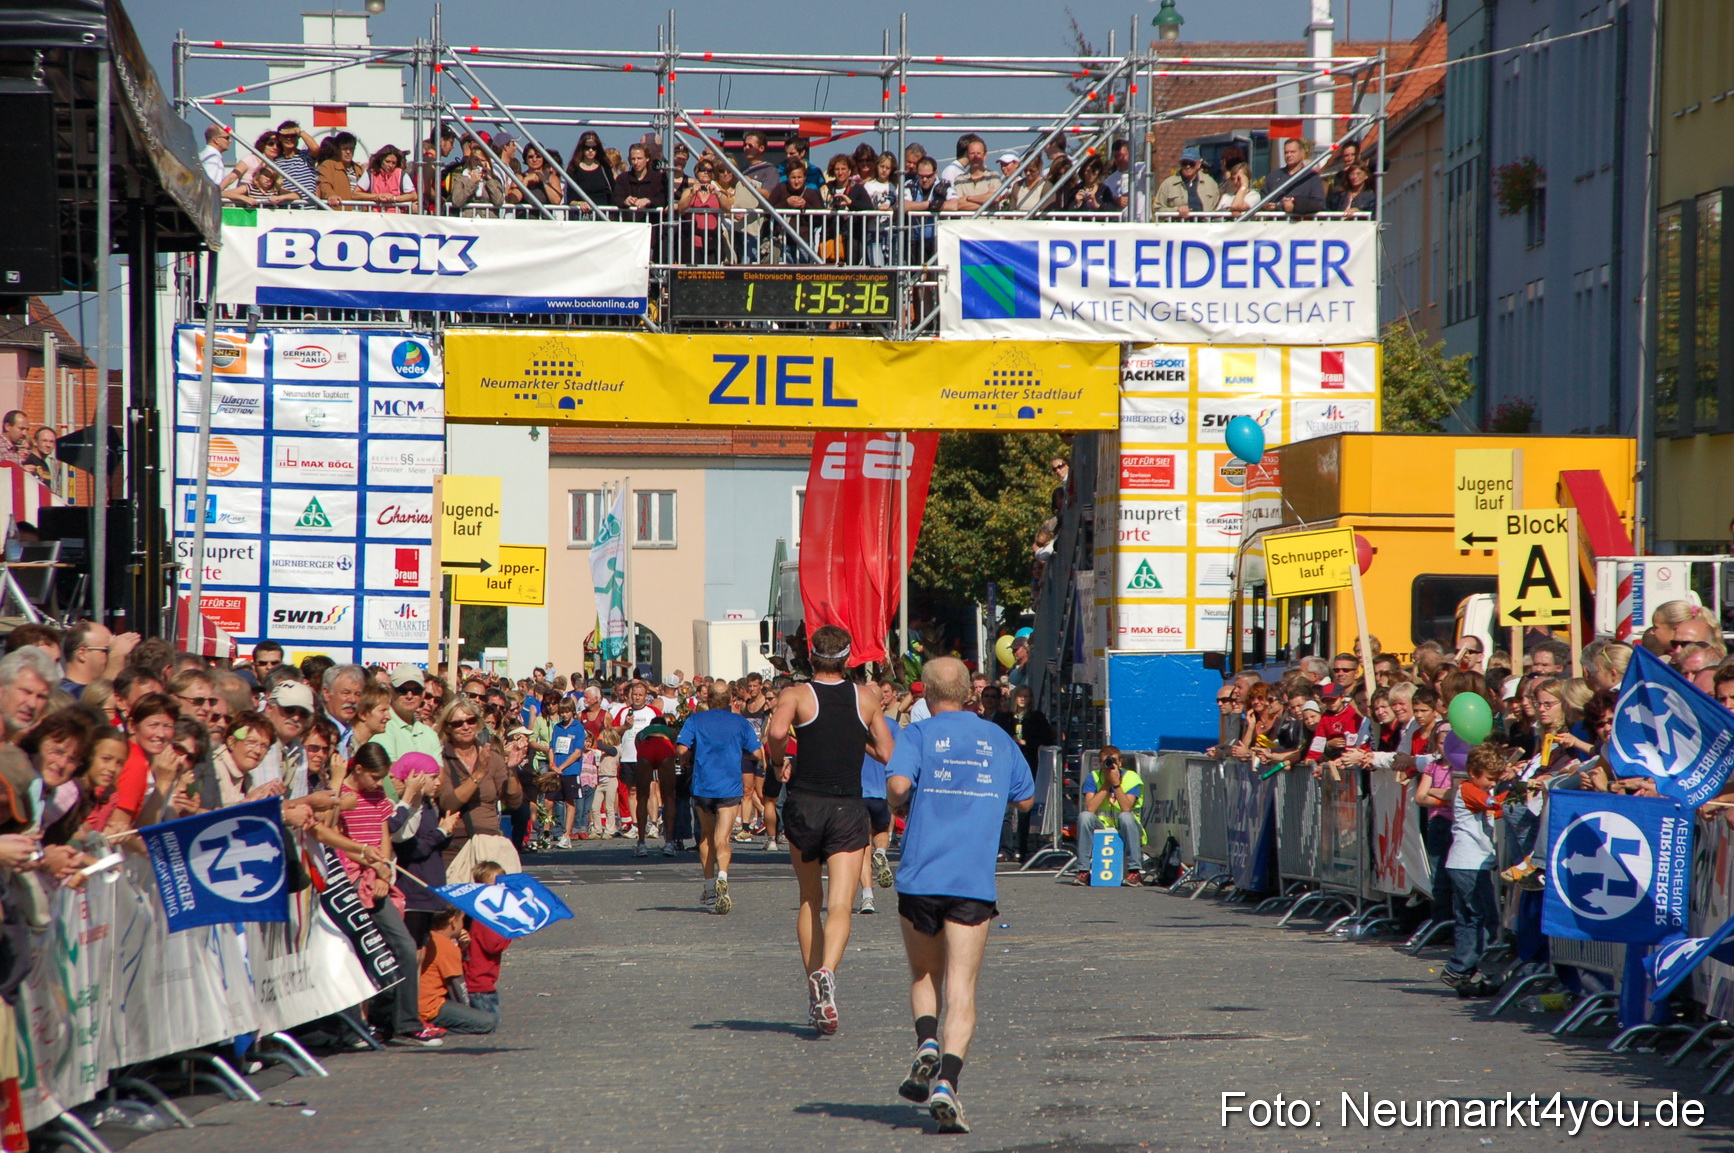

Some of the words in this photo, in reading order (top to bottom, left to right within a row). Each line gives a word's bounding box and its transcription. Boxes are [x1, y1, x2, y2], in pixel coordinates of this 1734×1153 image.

[258, 228, 479, 276] BOCK
[1048, 240, 1354, 288] PFLEIDERER
[743, 272, 793, 281] Elektronische
[547, 298, 640, 311] www.bockonline.de
[746, 282, 756, 312] 1
[794, 281, 890, 314] 1:35:36
[1049, 301, 1356, 324] AKTIENGESELLSCHAFT
[396, 364, 425, 375] vedes
[709, 354, 859, 409] ZIEL
[1320, 371, 1344, 384] Braun
[480, 377, 560, 392] Neumarkter
[563, 378, 624, 394] Stadtlauf
[221, 394, 259, 407] Wagner
[282, 390, 319, 399] Neumarkter
[322, 391, 350, 400] Tagblatt
[940, 388, 1020, 401] Neumarkter
[1022, 387, 1083, 401] Stadtlauf
[373, 400, 425, 416] MCM
[1120, 414, 1168, 424] RNBERGER
[1305, 420, 1360, 433] NEUMARKTER
[301, 459, 325, 468] MAX
[327, 458, 354, 468] BÖGL
[1122, 456, 1138, 466] GUT
[1139, 456, 1155, 466] FÜR
[1155, 457, 1171, 466] SIE!
[1475, 494, 1505, 511] lauf
[1119, 504, 1182, 526] inupret
[453, 520, 482, 536] lauf
[1507, 513, 1569, 535] Block
[1118, 529, 1151, 542] orte
[272, 557, 335, 569] NÜRNBERGER
[1270, 546, 1348, 567] Schnupper-
[394, 568, 418, 581] Braun
[1299, 564, 1325, 580] lauf
[1517, 544, 1562, 600] A
[487, 577, 512, 590] lauf
[207, 598, 225, 608] FÜR
[272, 608, 324, 623] swn
[1131, 626, 1153, 634] MAX
[1156, 625, 1182, 635] BÖGL
[1099, 835, 1114, 881] FOTO
[161, 831, 196, 912] NÜRNBERGER
